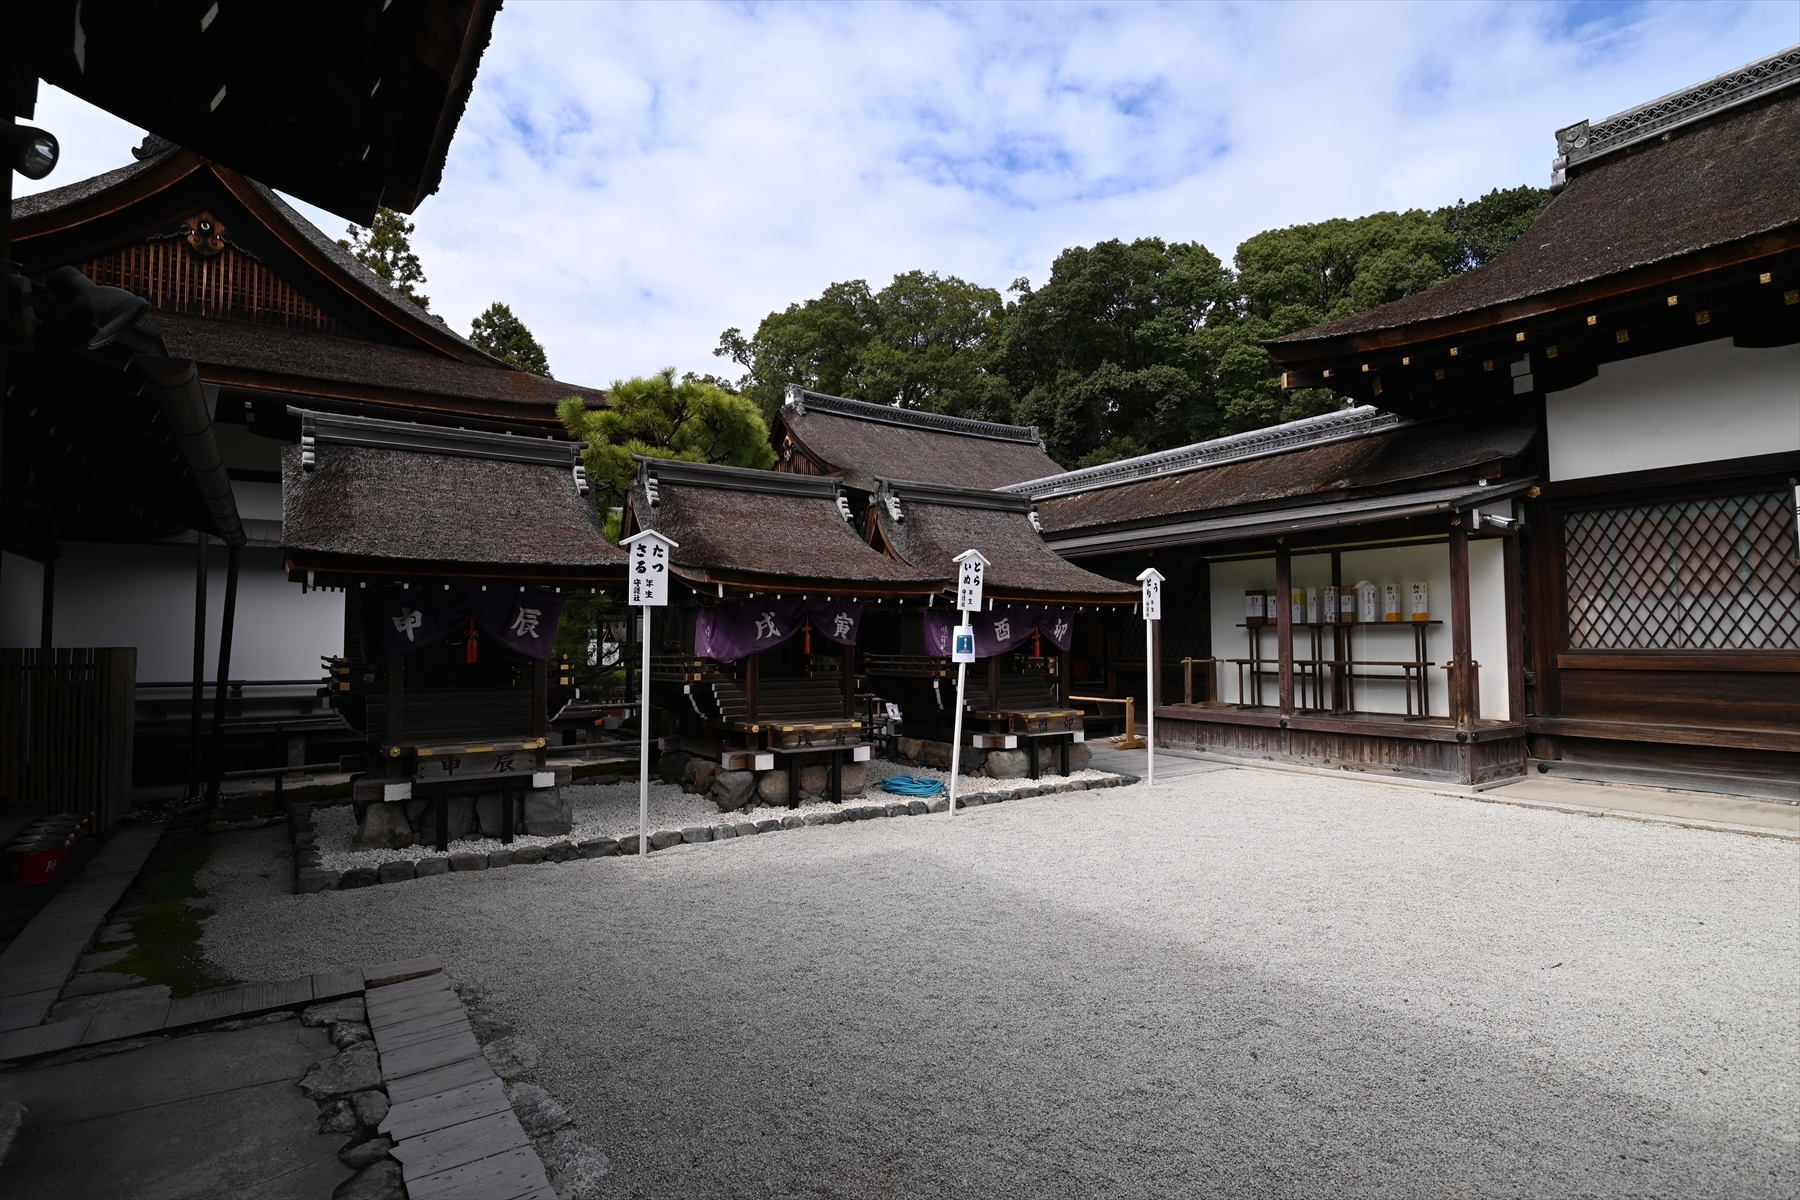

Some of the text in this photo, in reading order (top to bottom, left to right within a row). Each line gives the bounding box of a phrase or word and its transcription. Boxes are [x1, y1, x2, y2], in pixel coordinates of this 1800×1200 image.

[635, 543, 646, 574] さる
[652, 544, 664, 573] たつ
[963, 563, 971, 585] いぬ
[973, 561, 981, 586] とら
[645, 579, 654, 599] 年生
[391, 606, 422, 642] 申
[510, 606, 542, 639] 辰
[755, 611, 782, 641] 戌
[833, 611, 854, 640] 寅
[993, 617, 1011, 642] 酉
[1053, 617, 1068, 642] 卯
[441, 755, 460, 776] 申
[493, 754, 516, 772] 辰
